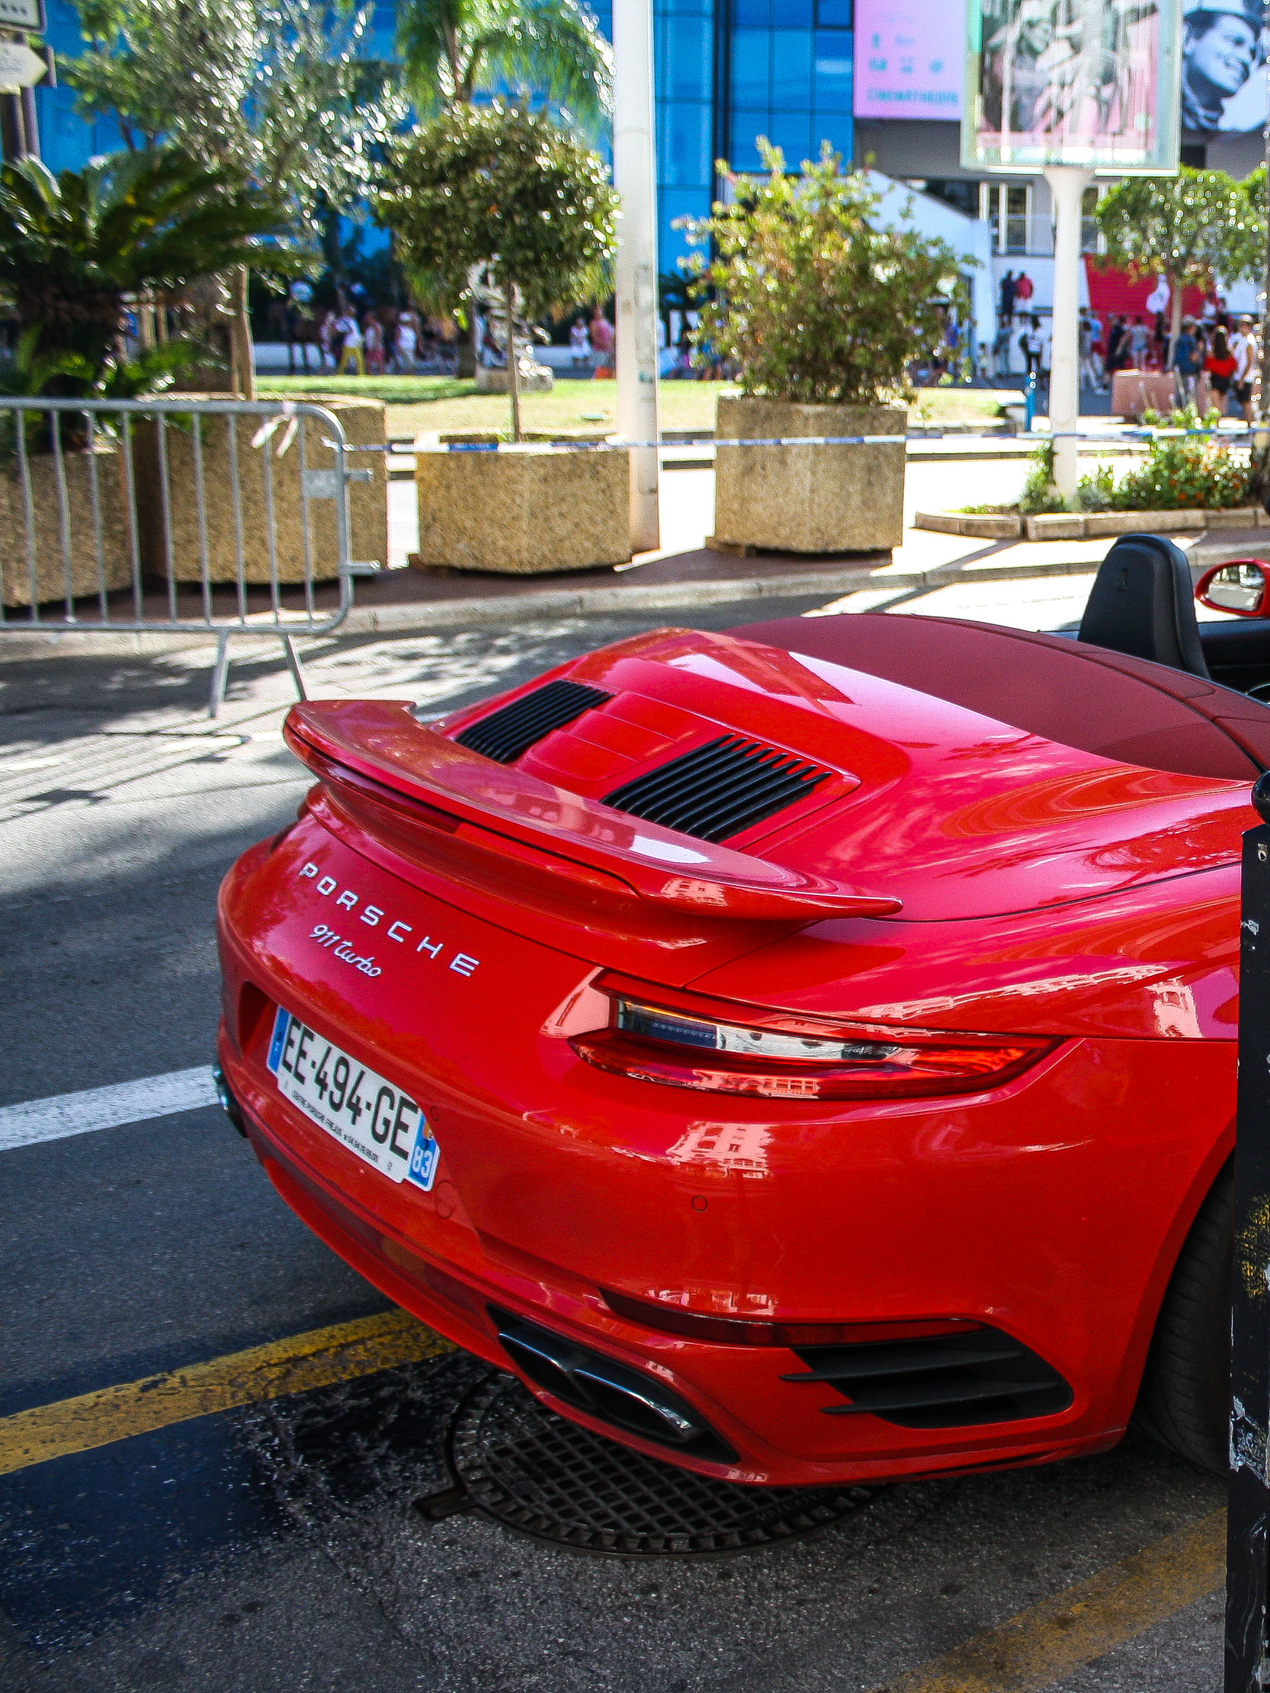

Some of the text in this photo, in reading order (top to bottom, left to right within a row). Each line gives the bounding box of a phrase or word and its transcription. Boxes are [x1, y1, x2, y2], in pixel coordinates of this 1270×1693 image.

[299, 863, 480, 977] PORSCHE
[309, 924, 382, 977] 911 turbo
[280, 1015, 419, 1161] EE-494-GE
[412, 1146, 432, 1178] 83
